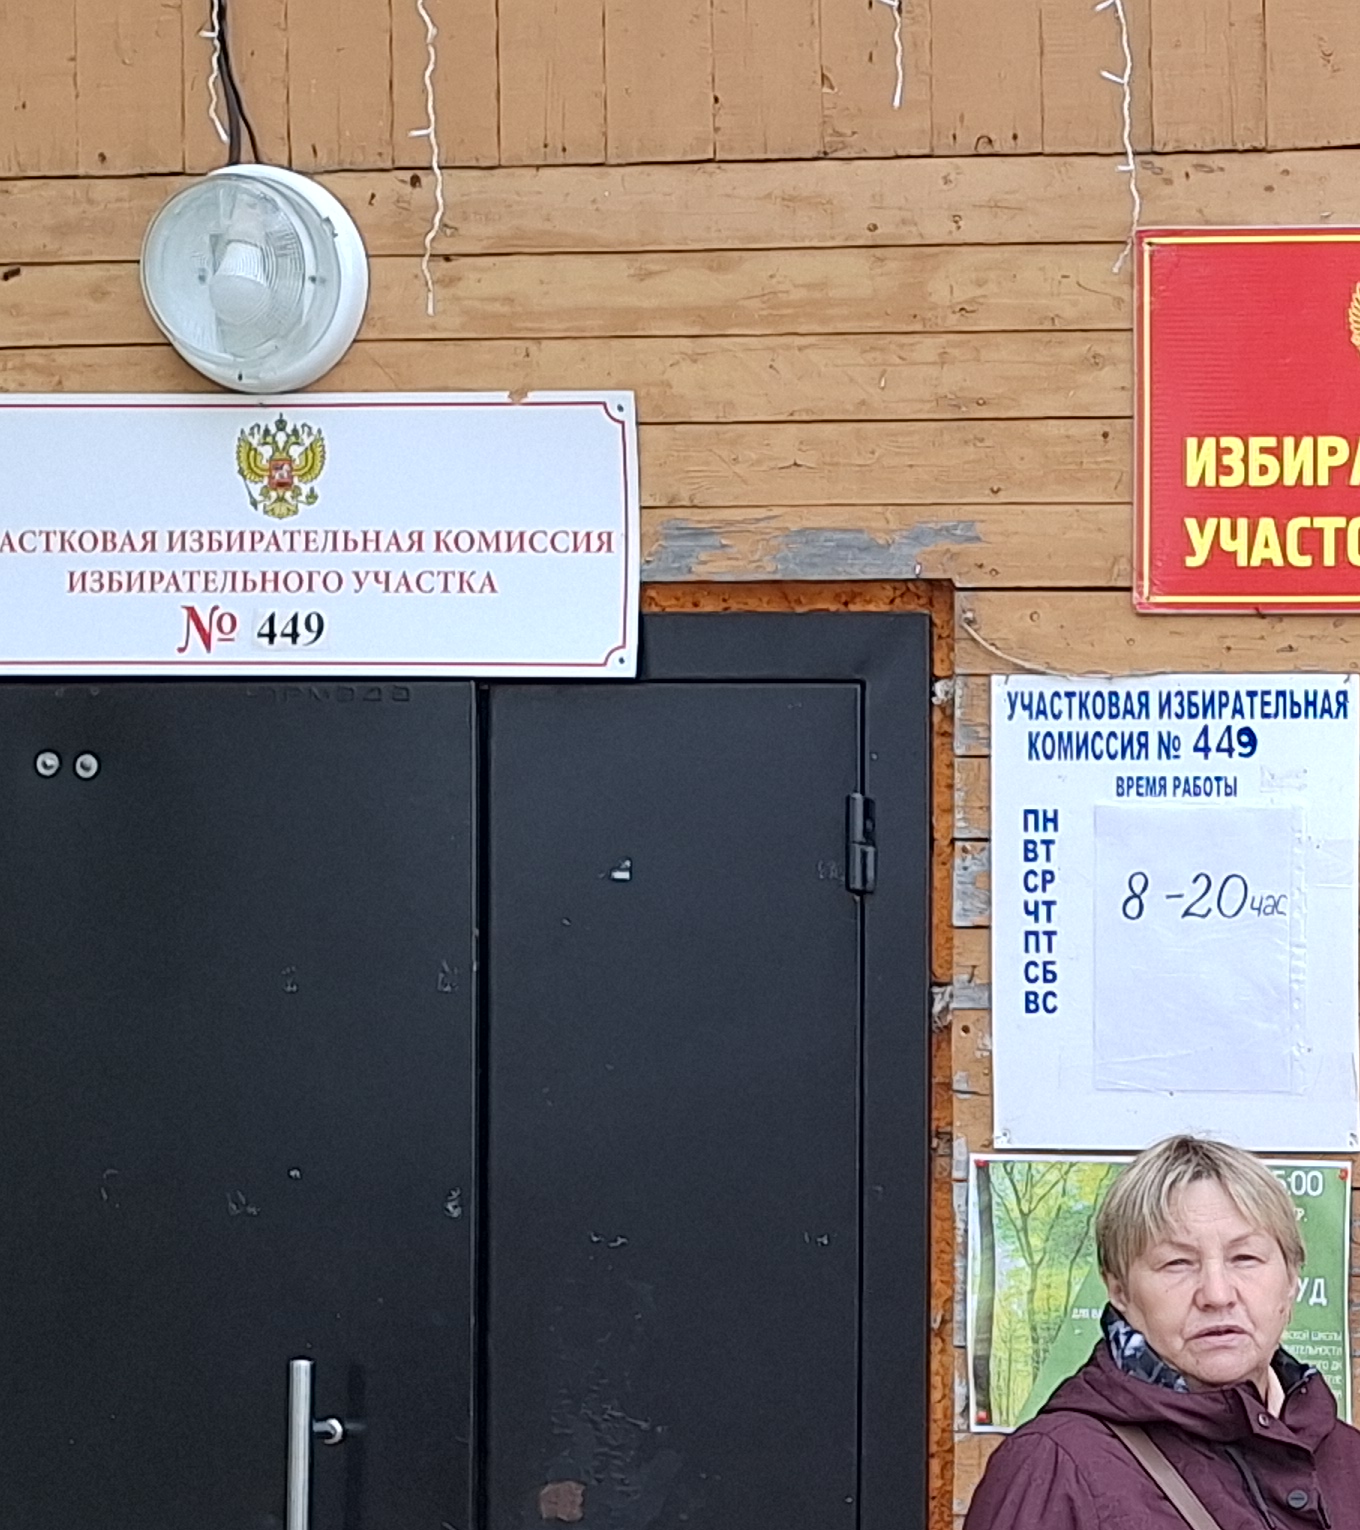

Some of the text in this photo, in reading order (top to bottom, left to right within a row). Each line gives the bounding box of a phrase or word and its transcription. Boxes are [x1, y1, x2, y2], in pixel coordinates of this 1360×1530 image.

[0, 530, 612, 553] АСТКОВАЯ ИЗБИРАТЕЛЬНАЯ КОМИССИЯ
[69, 571, 497, 593] ИЗБИРАТЕЛЬНОГО УЧАСТКА
[177, 605, 324, 653] № 449
[1007, 690, 1349, 720] УЧАСТКОВАЯ ИЗБИРАТЕЛЬНАЯ
[1028, 725, 1257, 760] КОМИССИЯ № 449
[1116, 776, 1237, 797] ВРЕМЯ РАБОТЫ
[1024, 809, 1058, 832] ПН
[1024, 839, 1055, 862] ВТ
[1024, 869, 1055, 893] СР
[1123, 872, 1148, 920] 8
[1250, 895, 1287, 916] час
[1024, 900, 1056, 923] ЧТ
[1025, 931, 1057, 953] ПТ
[1024, 961, 1057, 983] СБ
[1025, 991, 1057, 1013] ВС
